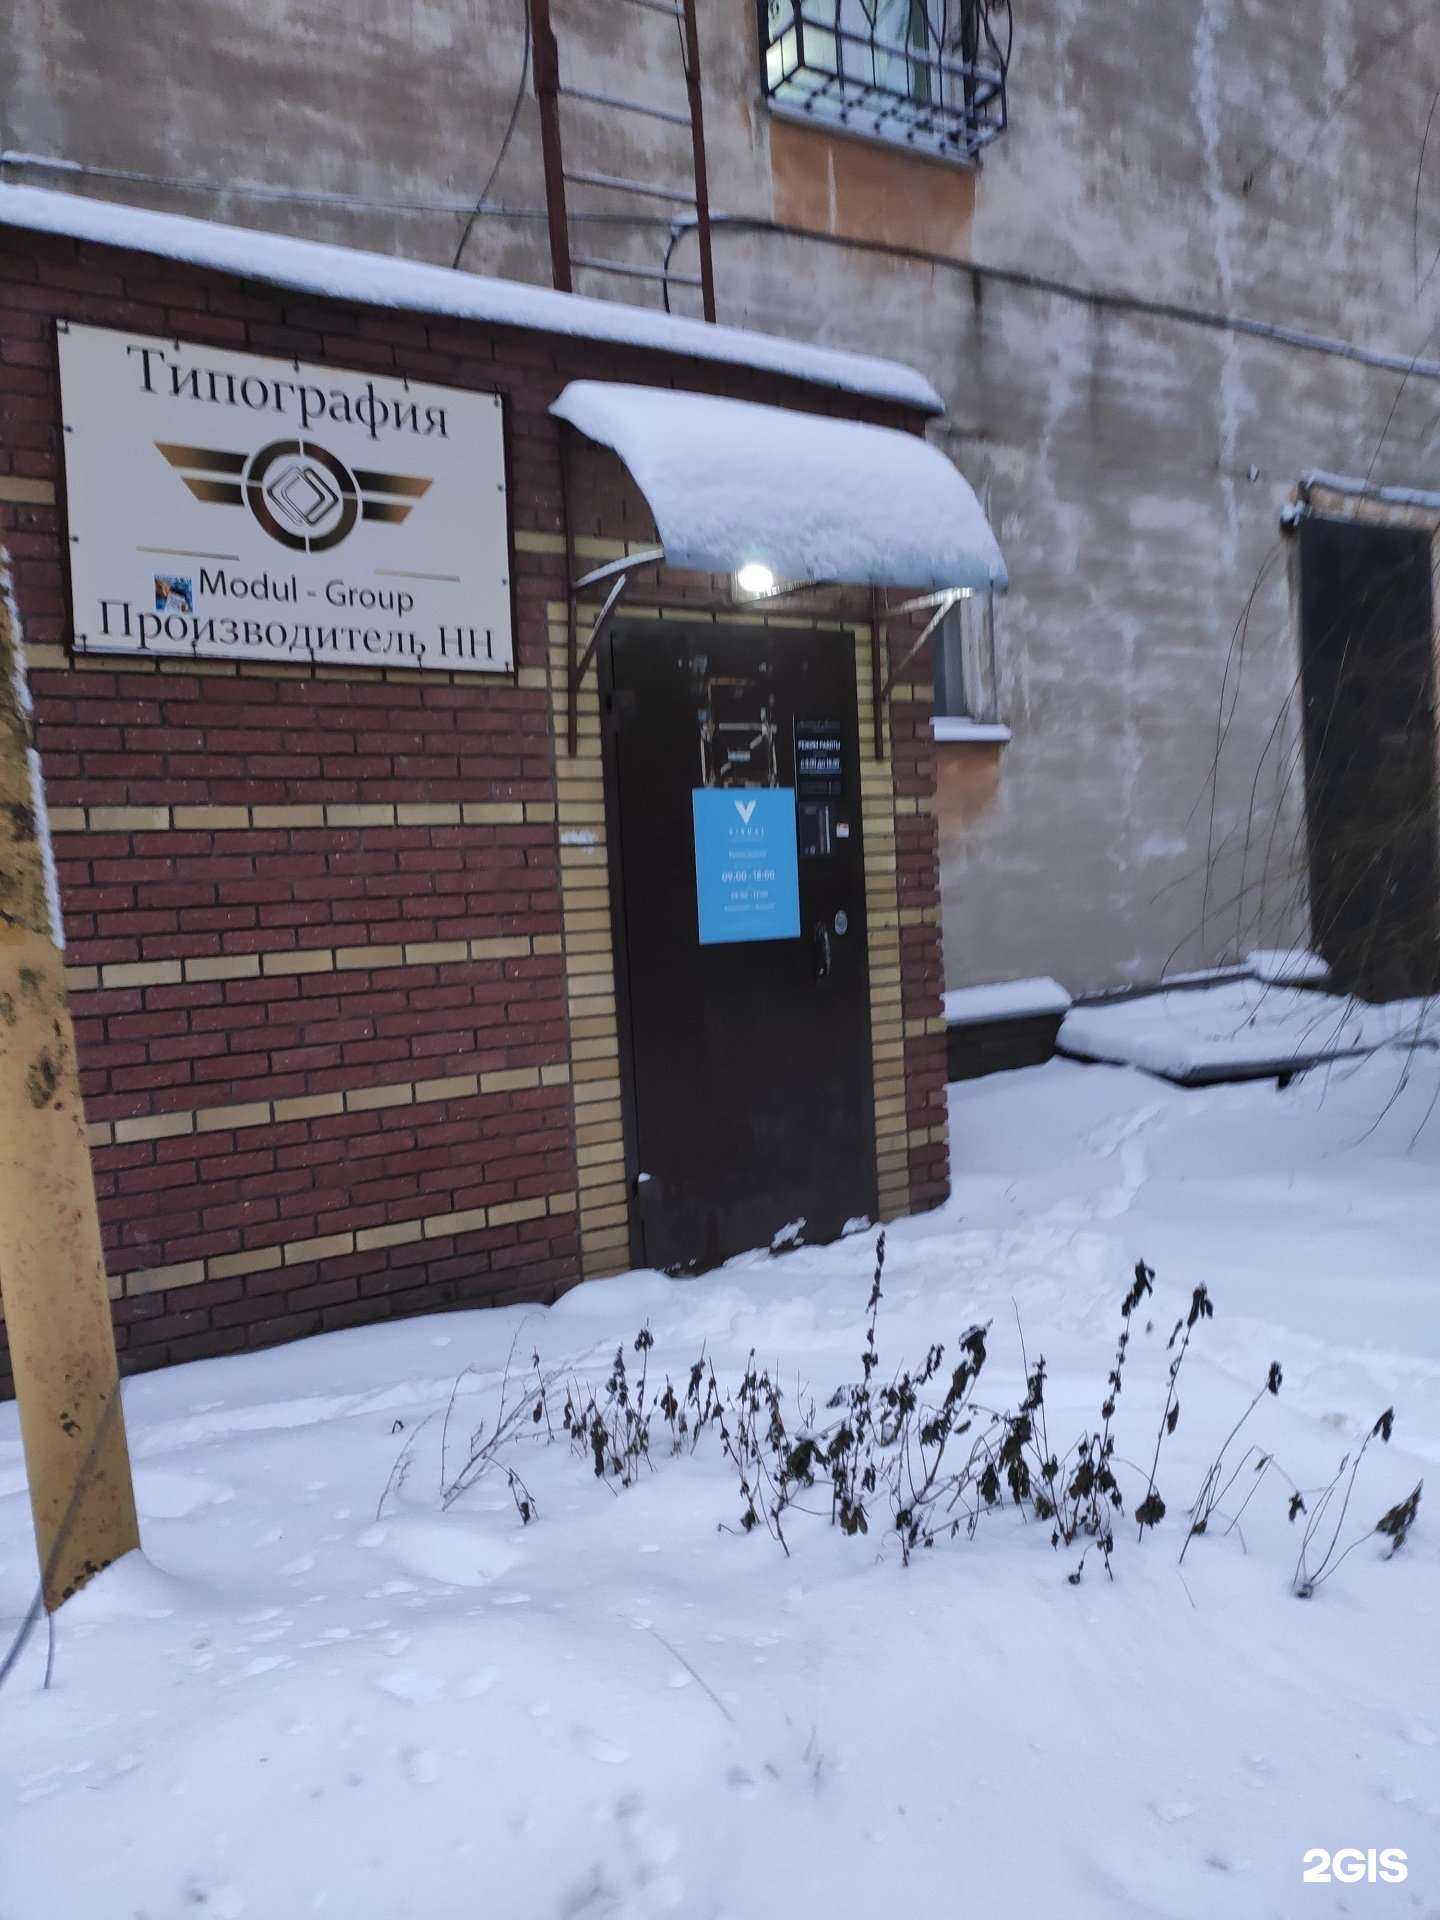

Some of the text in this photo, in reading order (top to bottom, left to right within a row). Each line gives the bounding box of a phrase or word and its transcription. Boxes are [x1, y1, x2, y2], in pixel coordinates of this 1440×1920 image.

[127, 346, 448, 440] Типография
[200, 568, 298, 602] Modul
[325, 581, 414, 616] Group
[99, 601, 495, 659] Производитель НН
